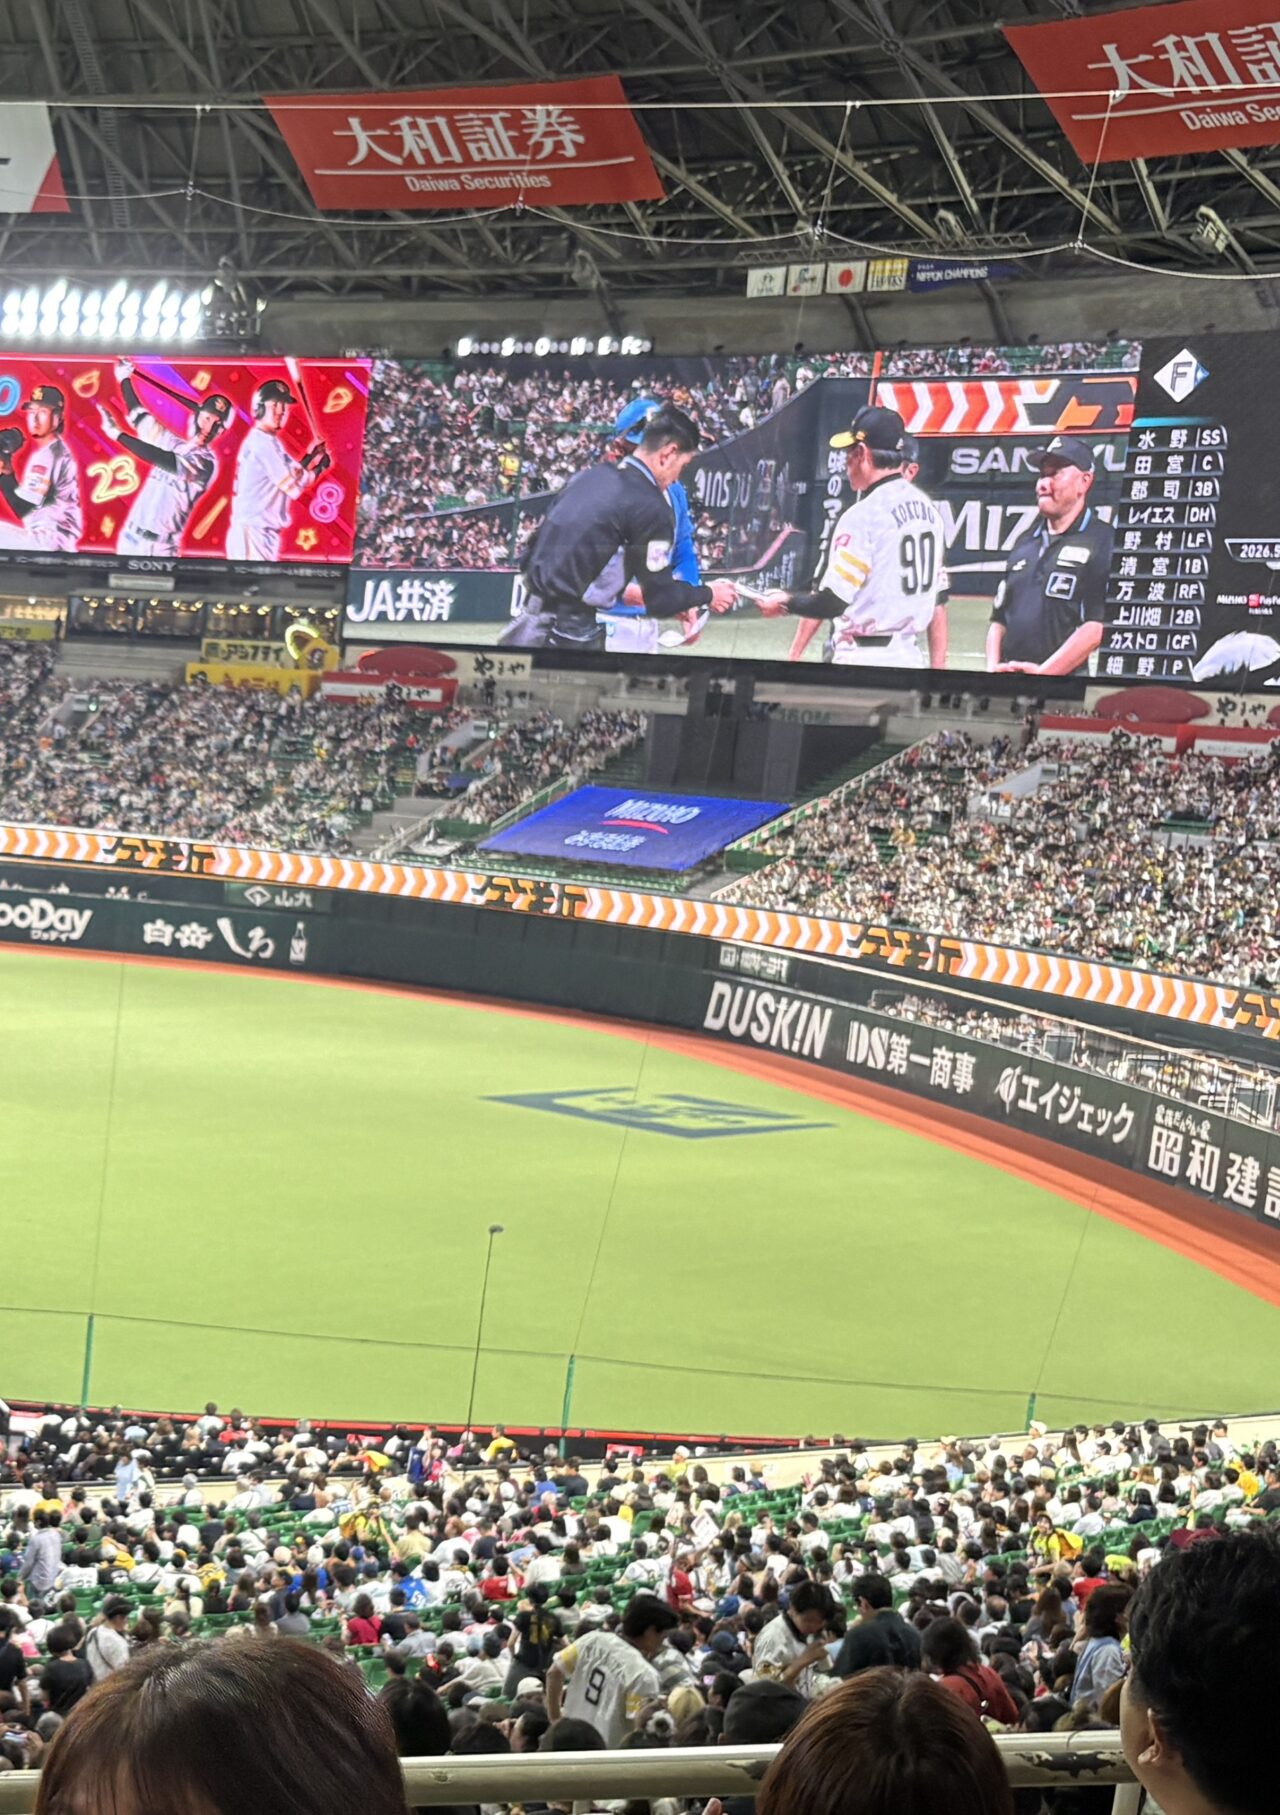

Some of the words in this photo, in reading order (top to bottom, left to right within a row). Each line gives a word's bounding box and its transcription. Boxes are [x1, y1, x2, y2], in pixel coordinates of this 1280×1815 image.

[1180, 107, 1248, 131] Daiwa
[333, 106, 585, 166] 大和証券
[405, 173, 460, 192] Daiwa
[461, 172, 551, 191] Securities
[1138, 429, 1187, 449] 水野
[1201, 429, 1220, 445] SS
[950, 444, 1127, 474] SANU
[1135, 454, 1184, 474] 田宮
[1202, 455, 1213, 470] C
[86, 456, 139, 504] 23
[1194, 481, 1213, 496] 3B
[308, 483, 345, 523] 8
[1129, 506, 1174, 524] レイエス
[1190, 507, 1210, 522] DH
[1123, 531, 1172, 550] 野村
[1187, 532, 1205, 547] LF
[128, 560, 177, 571] SONY
[900, 530, 935, 596] 90
[1185, 558, 1201, 574] 1B
[347, 580, 456, 622] JA共済
[1116, 581, 1165, 601] 万波
[1179, 584, 1198, 599] RF
[1112, 606, 1161, 626] 上川畑
[1175, 609, 1194, 624] 2B
[1110, 632, 1158, 650] カストロ
[1172, 634, 1190, 649] CF
[1172, 660, 1183, 675] P
[604, 799, 702, 824] MIZUHO
[275, 890, 313, 908] 山九
[216, 916, 276, 960] しろ
[703, 981, 832, 1059] DUSKIN
[887, 1032, 976, 1094] 第一商事
[1017, 1075, 1134, 1143] エイジェック
